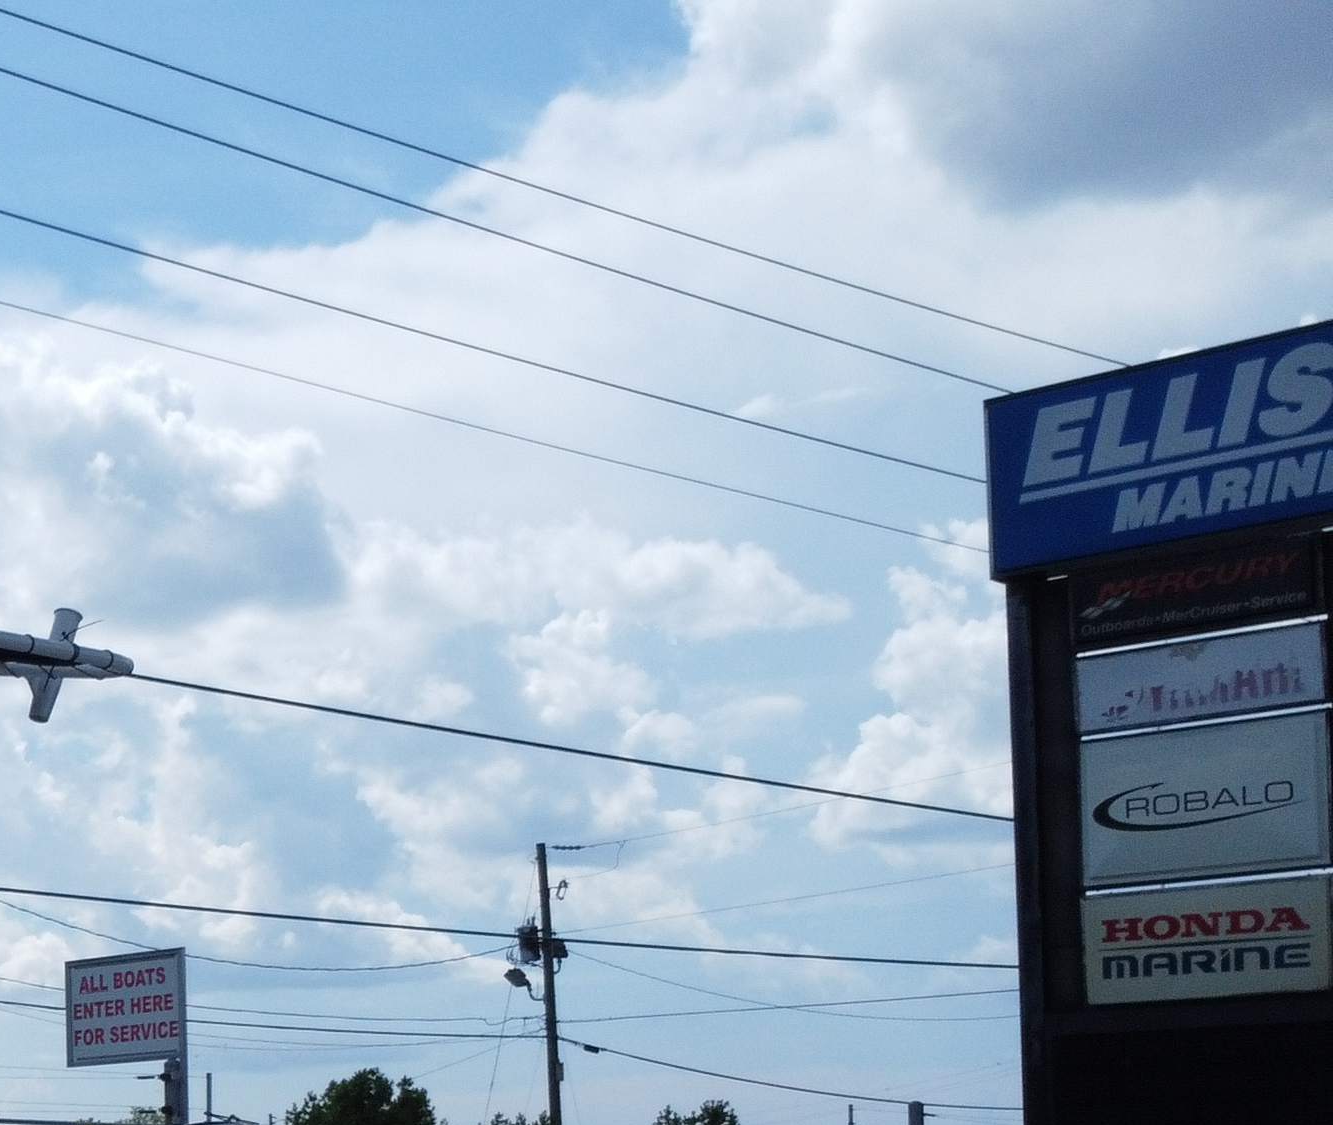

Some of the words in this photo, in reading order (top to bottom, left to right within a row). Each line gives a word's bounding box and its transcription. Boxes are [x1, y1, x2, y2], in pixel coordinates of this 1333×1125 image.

[1022, 342, 1333, 487] ELLIS
[1112, 449, 1333, 533] MARIN
[1097, 552, 1300, 604] MERCURY
[1126, 780, 1295, 819] ROBALO
[1101, 907, 1311, 944] HONDA
[1102, 943, 1311, 979] MARINE
[79, 974, 108, 994] ALL
[113, 967, 166, 990] BOATS
[73, 999, 125, 1020] ENTER
[130, 993, 174, 1014] HERE
[74, 1028, 105, 1046] FOR
[109, 1020, 179, 1044] SERVICE
